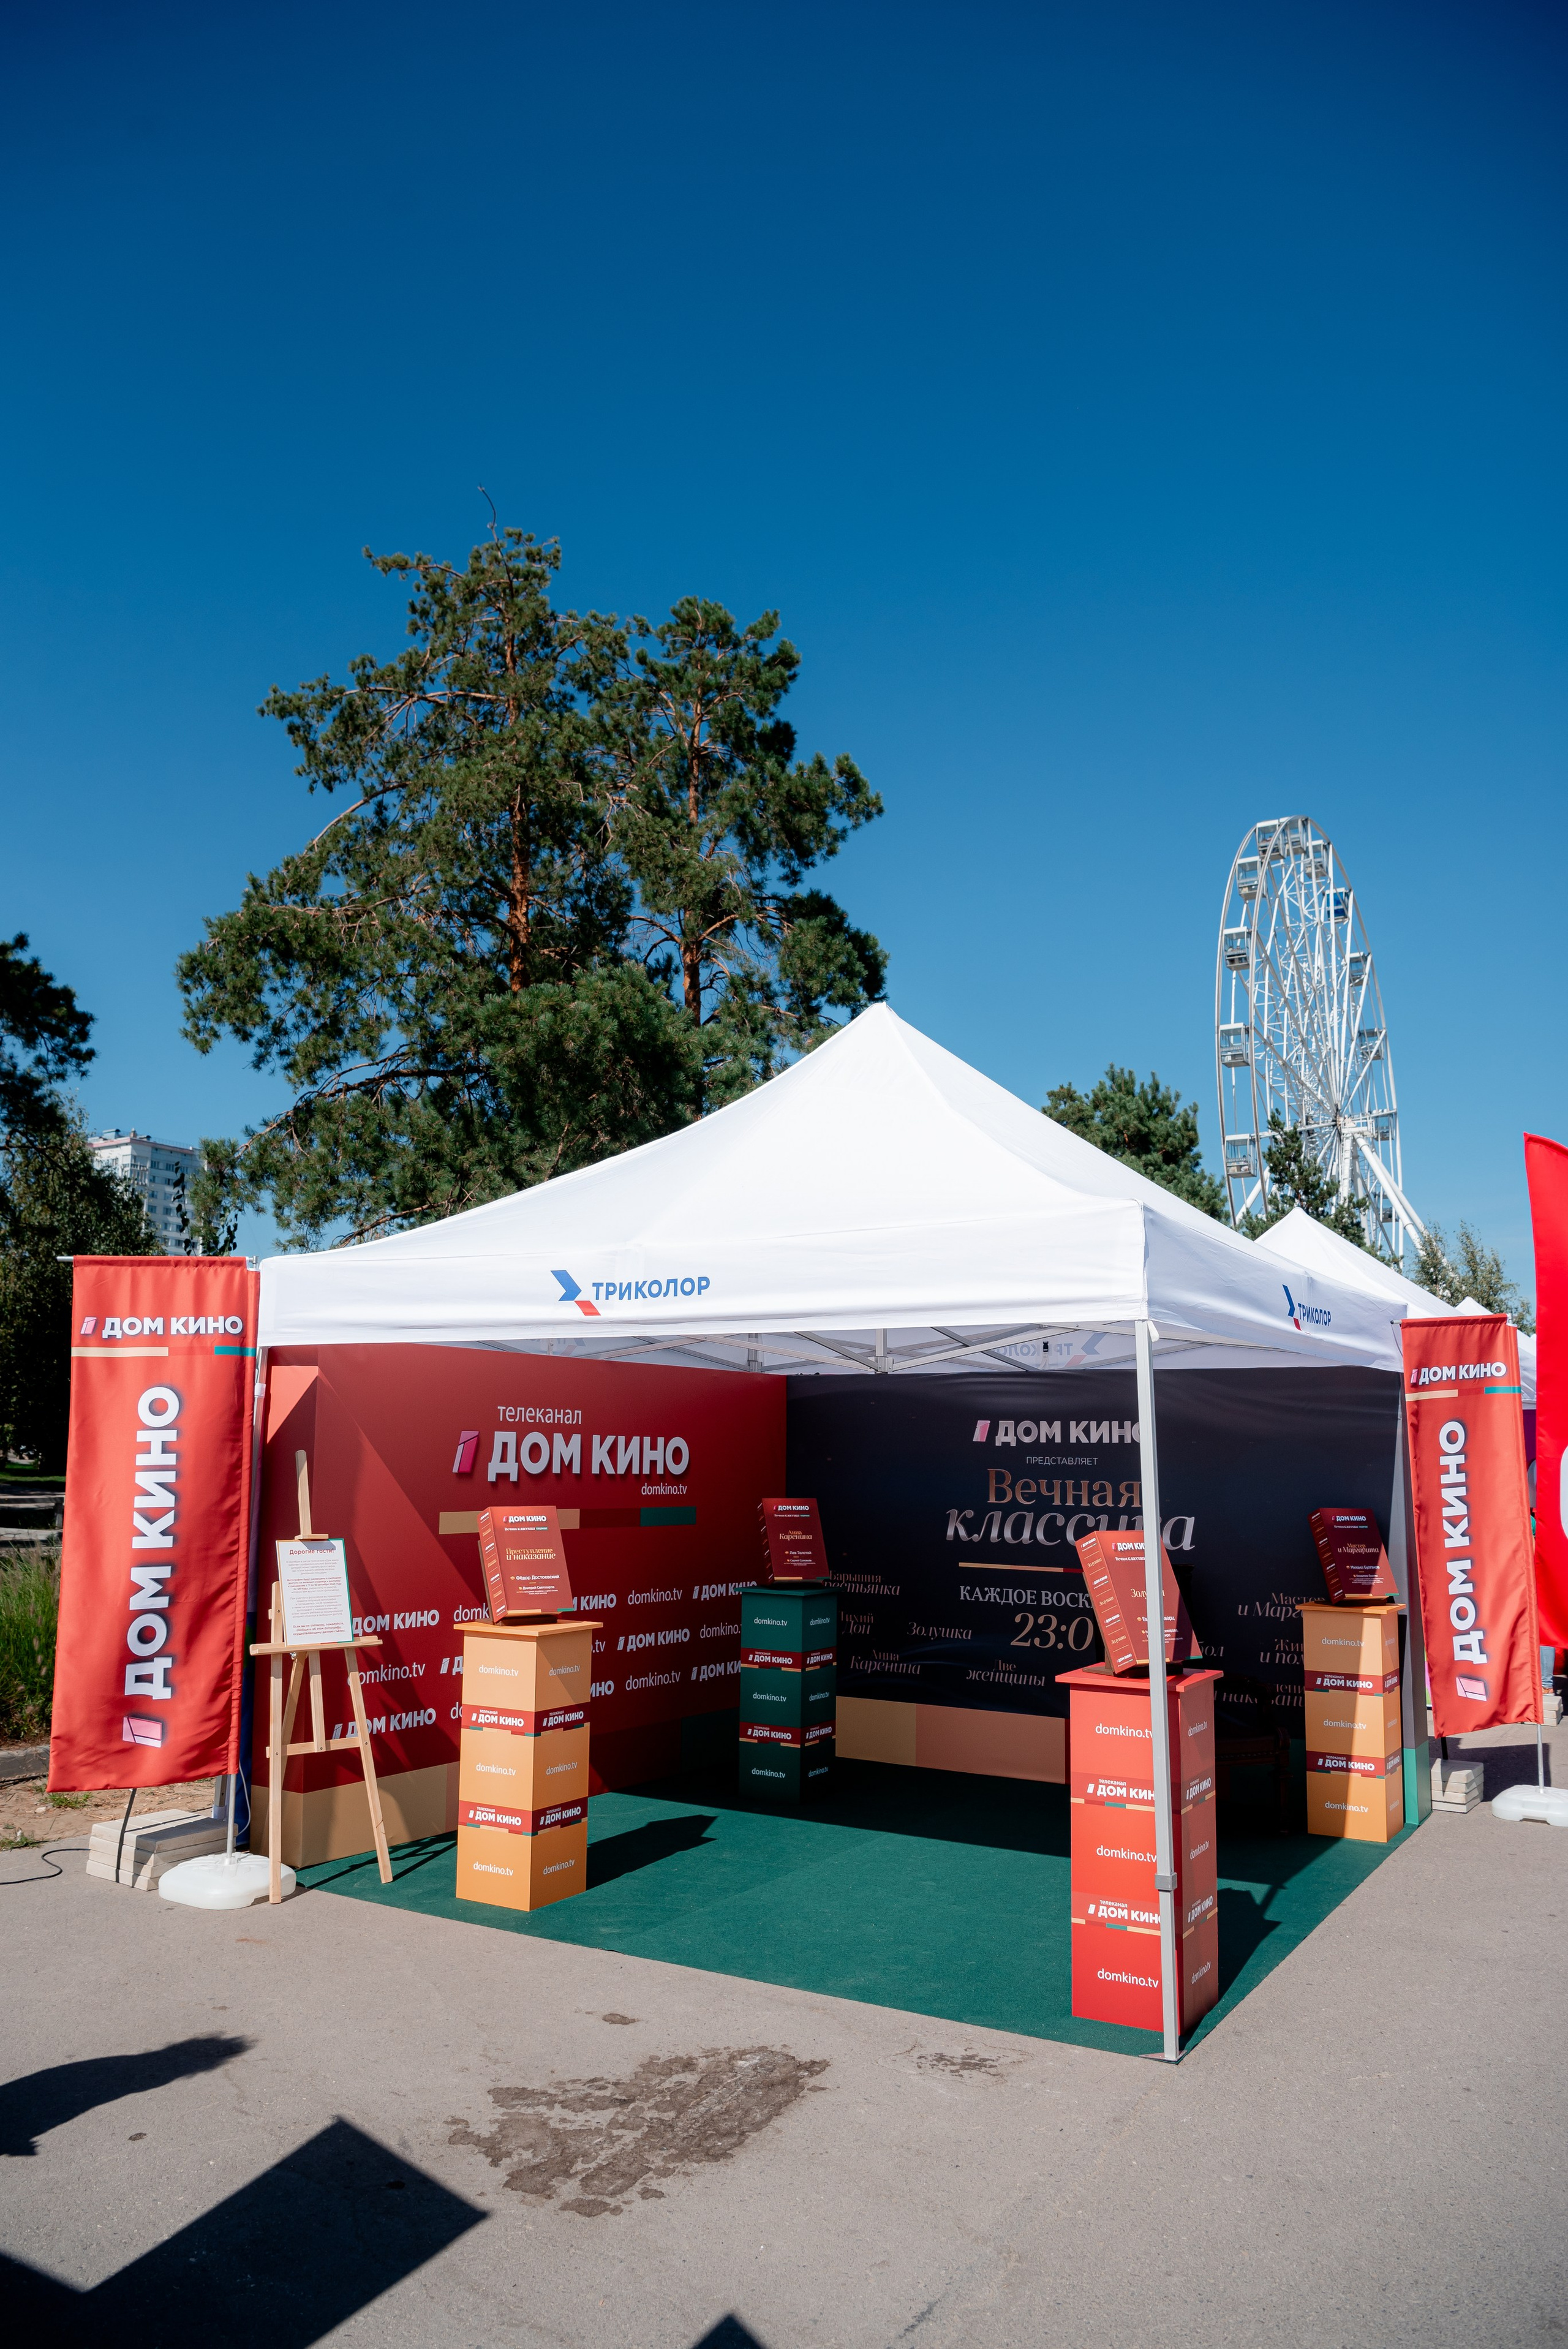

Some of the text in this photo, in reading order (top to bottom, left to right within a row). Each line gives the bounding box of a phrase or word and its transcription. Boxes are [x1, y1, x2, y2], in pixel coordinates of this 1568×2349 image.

[592, 1276, 710, 1300] ТРИКОЛОР
[1297, 1302, 1332, 1327] ТРИКОЛОР
[102, 1316, 243, 1339] ДОМ КИНО
[1419, 1362, 1507, 1386] ДОМ КИНО
[497, 1405, 582, 1425] телеканал
[995, 1420, 1061, 1446] ДОМ
[488, 1431, 690, 1482] ДОМ КИНО
[1026, 1456, 1098, 1466] ПРЕДСТАВЛЯЕТ
[641, 1482, 687, 1495] domkino.tv
[987, 1468, 1142, 1507] Вечная
[946, 1509, 1196, 1551] класса
[124, 1386, 180, 1700] ДОМ КИНО
[1117, 1542, 1134, 1552] ДОМ
[1439, 1420, 1488, 1664] ДОМ КИНО
[627, 1588, 682, 1605] domkino.tv
[701, 1583, 726, 1601] ДОМ
[960, 1585, 1037, 1606] КАЖДОЕ
[1041, 1591, 1093, 1608] ВОСК
[580, 1593, 617, 1611] КИНО
[840, 1610, 873, 1623] Тихий
[1237, 1602, 1303, 1621] и Марг
[352, 1609, 440, 1637] ДОМ КИНО
[754, 1617, 788, 1626] domkino.tv
[842, 1621, 871, 1635] Дон
[699, 1623, 742, 1638] domkino.
[907, 1621, 973, 1641] Золушка
[627, 1633, 655, 1652] ДОМ
[657, 1628, 690, 1646] КИНО
[1322, 1637, 1365, 1646] domkino.tv
[754, 1654, 771, 1663] ДОМ
[810, 1653, 833, 1664] ДОМ КИНО
[871, 1650, 899, 1661] Анна
[1259, 1652, 1270, 1664] и
[347, 1661, 426, 1686] omkino.tv
[479, 1664, 519, 1676] domkino.tv
[549, 1664, 581, 1676] domkino.tv
[699, 1662, 725, 1681] ДОМ
[850, 1656, 921, 1674] Каренина
[993, 1659, 1017, 1672] Две
[625, 1671, 680, 1691] domkino.tv
[966, 1668, 1046, 1687] женщины
[1346, 1680, 1373, 1689] КИНО
[753, 1692, 786, 1702] domkino.tv
[390, 1708, 436, 1732] КИНО
[478, 1714, 524, 1727] ДОМ КИНО
[548, 1711, 584, 1727] ДОМ КИНО
[1324, 1719, 1366, 1730] domkino.tv
[771, 1731, 792, 1740] КИНО
[809, 1726, 832, 1739] ДОМ КИНО
[1188, 1721, 1208, 1737] domkino.tv
[476, 1762, 516, 1776] domkino.tv
[546, 1761, 578, 1776] domkino.tv
[752, 1768, 786, 1778] domkino.tv
[1325, 1759, 1375, 1771] ДОМ КИНО
[1096, 1784, 1127, 1797] ДОМ
[1189, 1777, 1212, 1800] ДОМ КИНО
[545, 1806, 581, 1825] ДОМ КИНО
[1325, 1801, 1368, 1813] domkino.tv
[475, 1811, 522, 1826] ДОМ КИНО
[1096, 1845, 1157, 1863] domkino.tv
[1190, 1840, 1210, 1860] domkino.tv
[473, 1861, 514, 1876] domkino.tv
[543, 1859, 575, 1875] domkino.tv
[1098, 1906, 1161, 1924] ДОМ КИН
[1190, 1895, 1213, 1922] ДОМ КИНО
[1097, 1968, 1159, 1988] domkino.tv
[1191, 1961, 1212, 1985] domkino.tv
